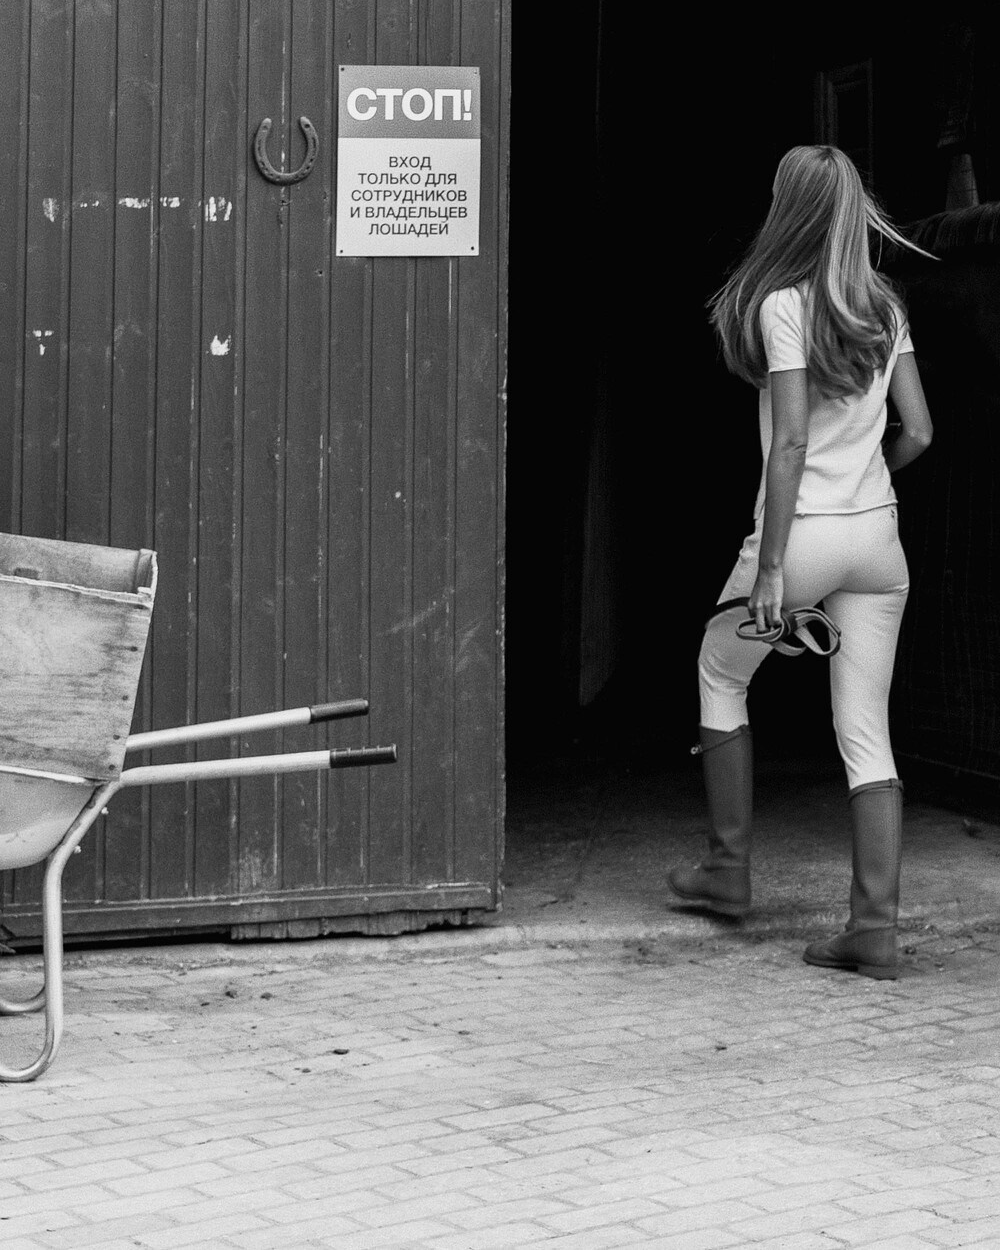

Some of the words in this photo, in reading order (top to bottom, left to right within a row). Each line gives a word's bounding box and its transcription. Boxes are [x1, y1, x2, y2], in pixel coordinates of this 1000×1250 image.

[346, 87, 472, 121] СТОП!
[388, 156, 432, 170] ВХОД
[358, 173, 421, 185] ТОЛЬКО
[424, 173, 457, 187] ДЛЯ
[350, 190, 468, 204] СОТРУДНИКОВ
[350, 207, 361, 218] И
[365, 207, 468, 221] ВЛАДЕЛЬЦЕВ
[368, 220, 449, 237] ЛОШАДЕЙ
